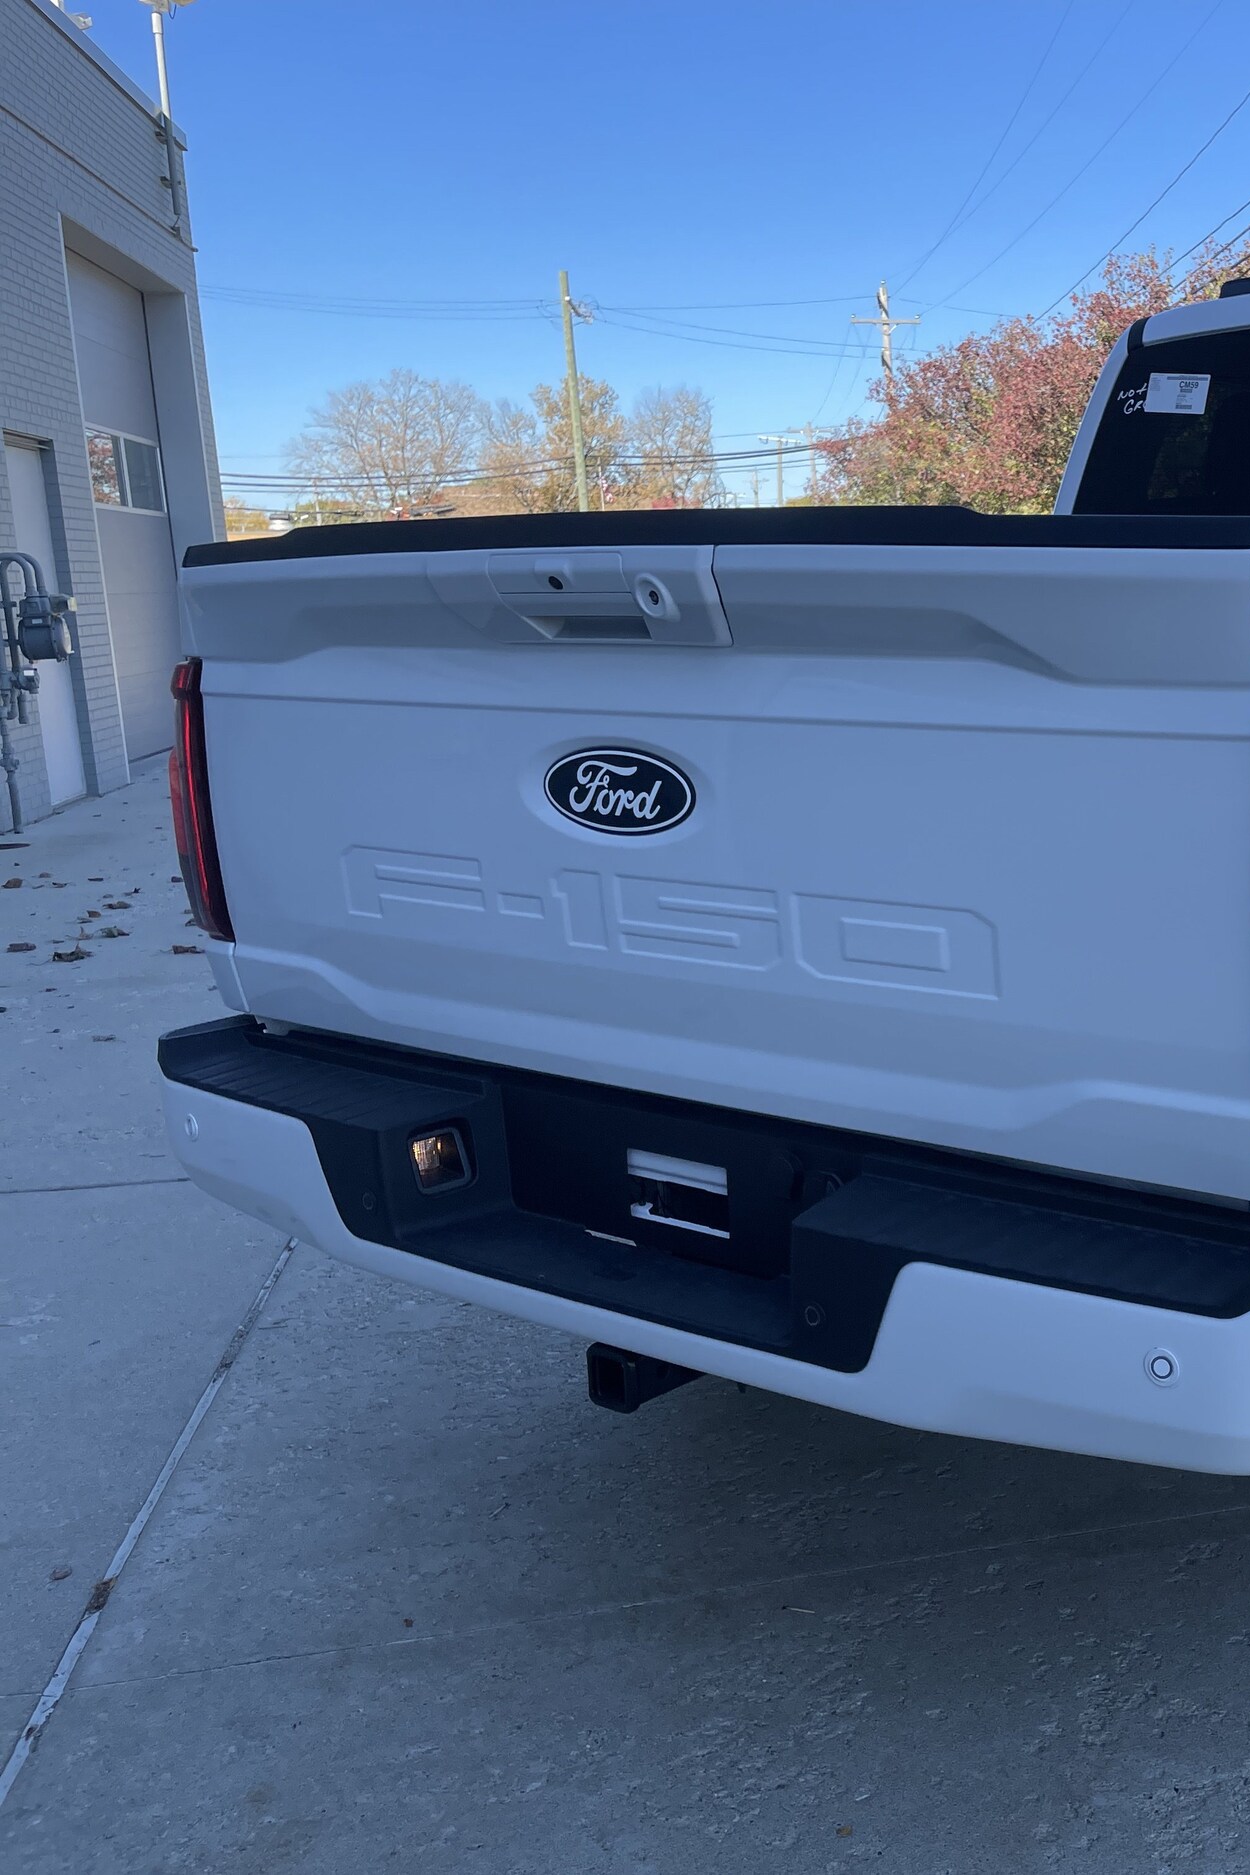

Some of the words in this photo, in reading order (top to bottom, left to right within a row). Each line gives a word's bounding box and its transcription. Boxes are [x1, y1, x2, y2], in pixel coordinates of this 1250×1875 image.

[1179, 380, 1199, 389] CM59
[568, 759, 662, 820] Ford
[341, 844, 1001, 1000] F-150
